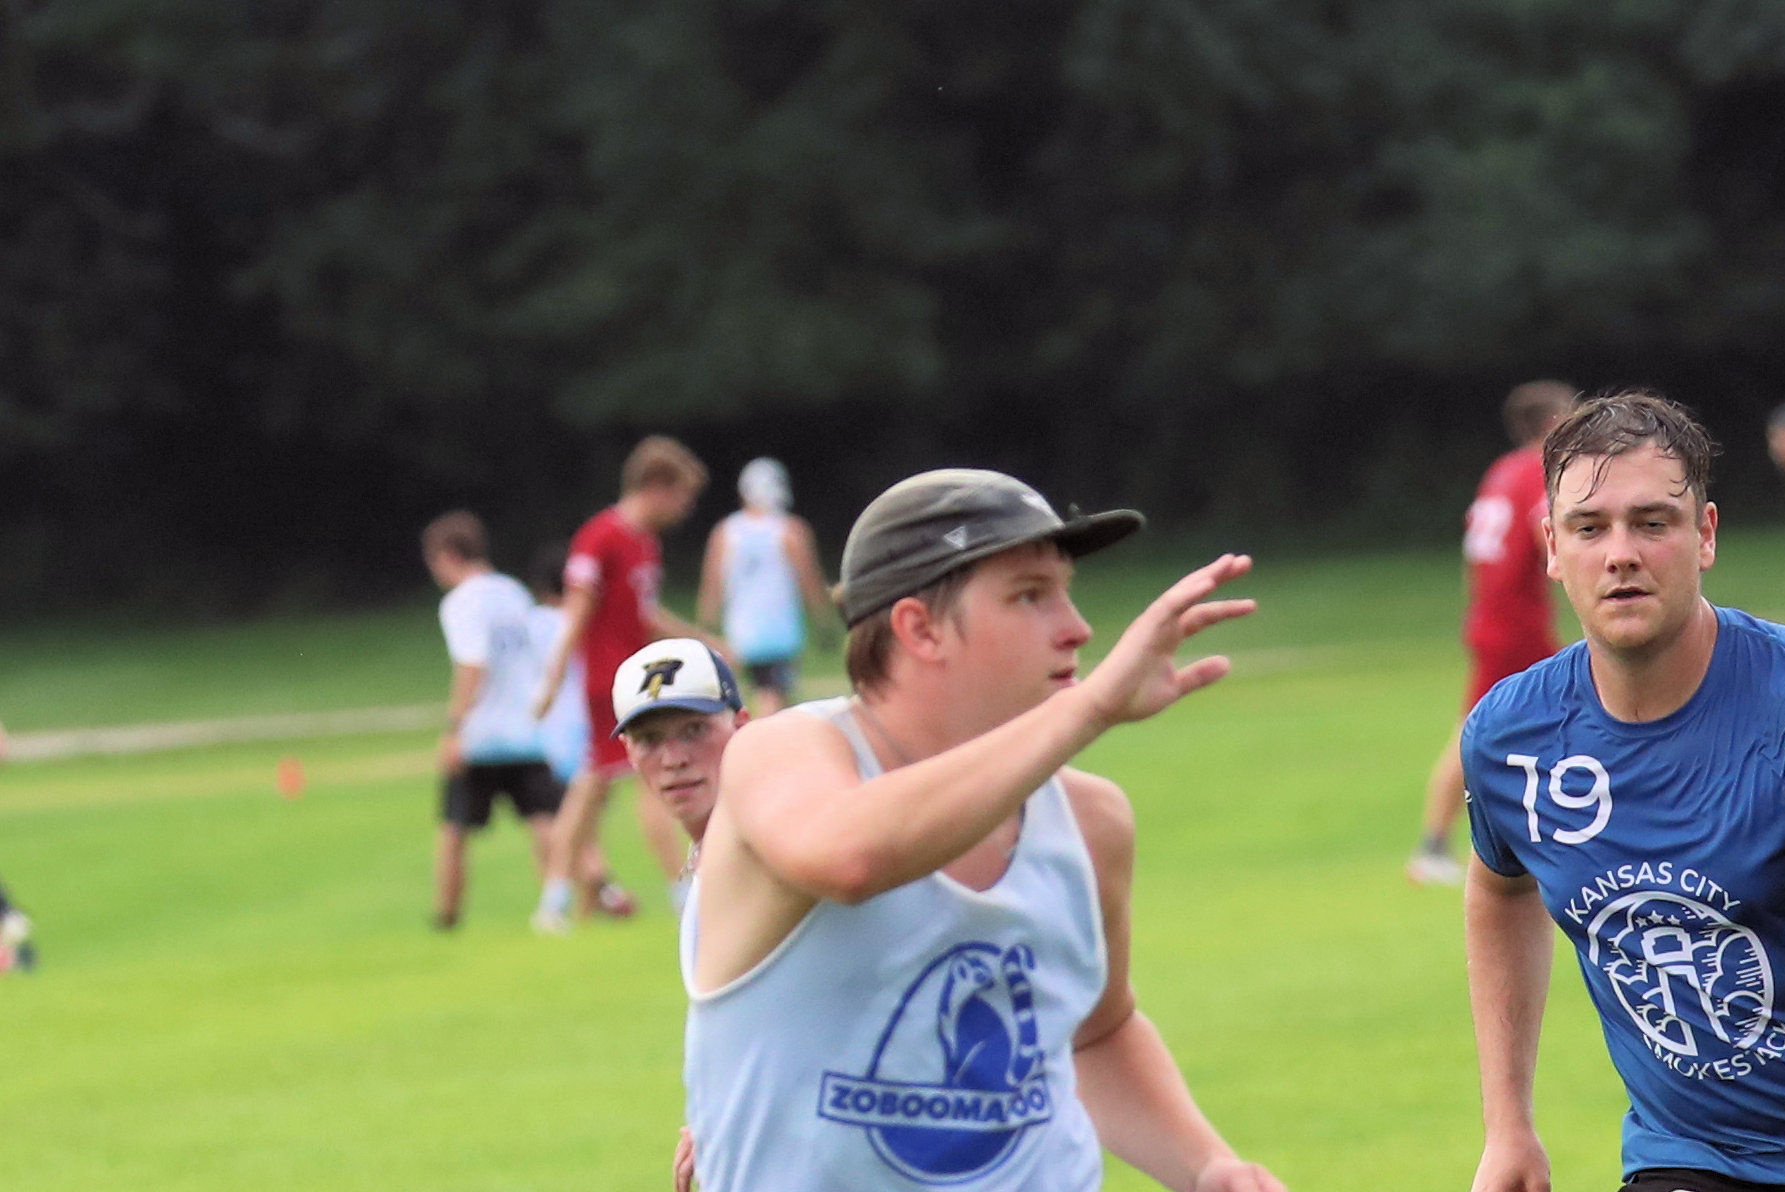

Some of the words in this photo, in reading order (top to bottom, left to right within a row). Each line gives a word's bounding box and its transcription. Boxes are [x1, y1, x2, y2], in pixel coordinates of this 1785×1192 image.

[1506, 753, 1613, 845] 19
[1564, 861, 1674, 925] KANSAS
[1679, 868, 1741, 912] CITY
